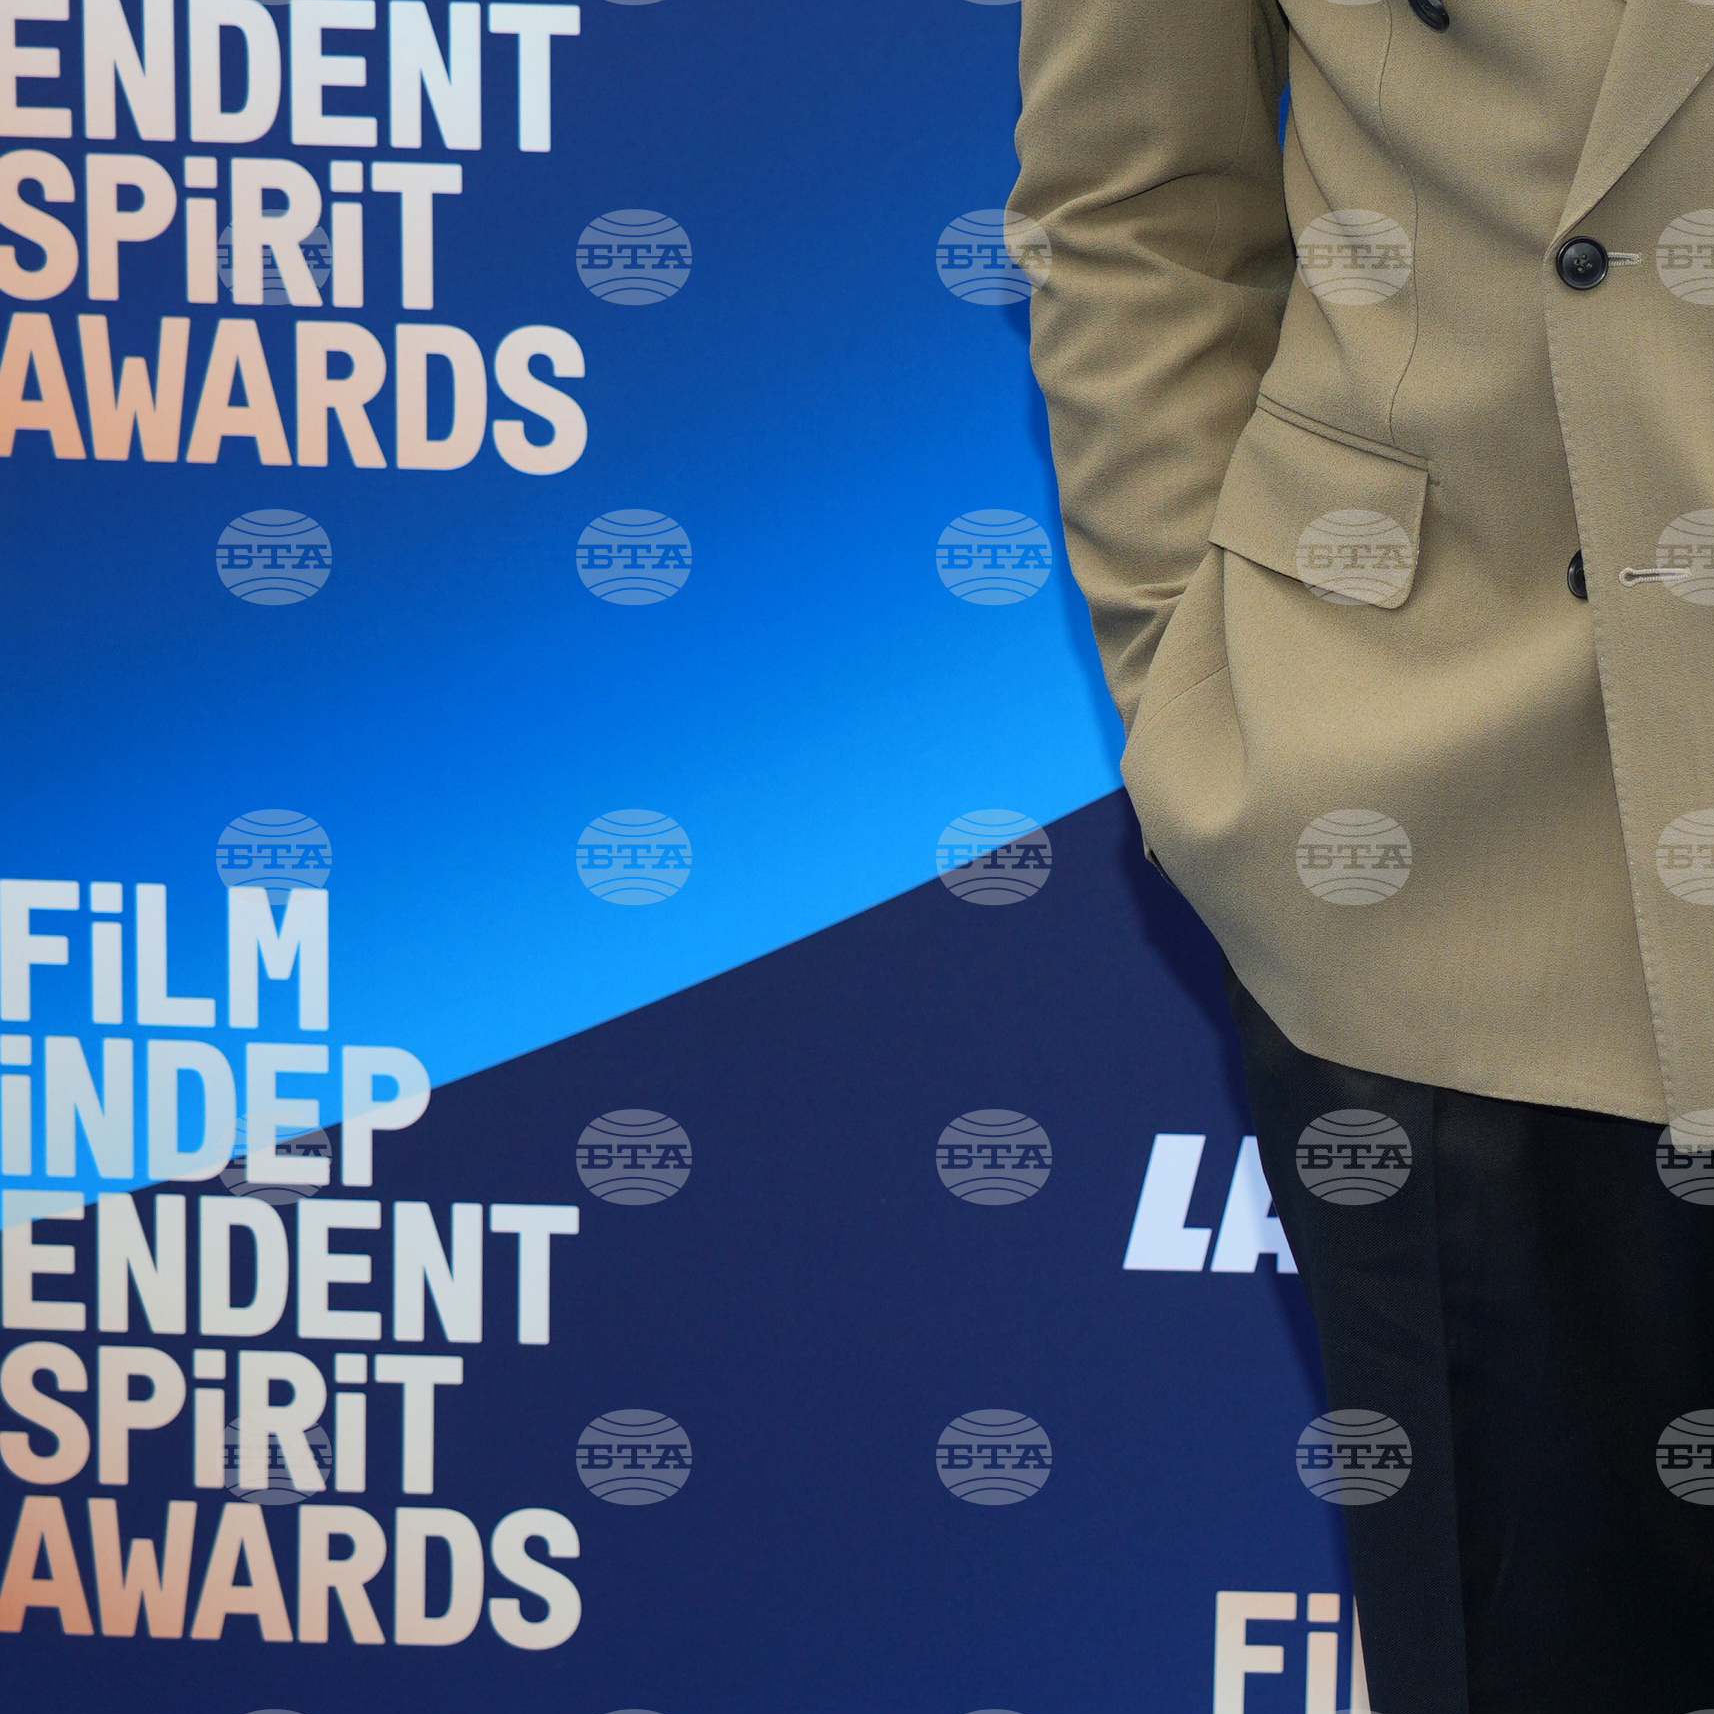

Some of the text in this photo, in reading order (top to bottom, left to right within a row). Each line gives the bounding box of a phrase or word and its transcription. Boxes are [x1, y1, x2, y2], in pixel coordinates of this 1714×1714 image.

[0, 150, 463, 310] SPiRiT
[0, 313, 588, 475] AWARDS
[0, 878, 329, 1031] FiLM
[0, 1035, 431, 1187] iNDEP
[0, 1189, 579, 1345] ENDENT
[0, 1341, 463, 1495] SPiRiT
[0, 1496, 582, 1650] AWARDS
